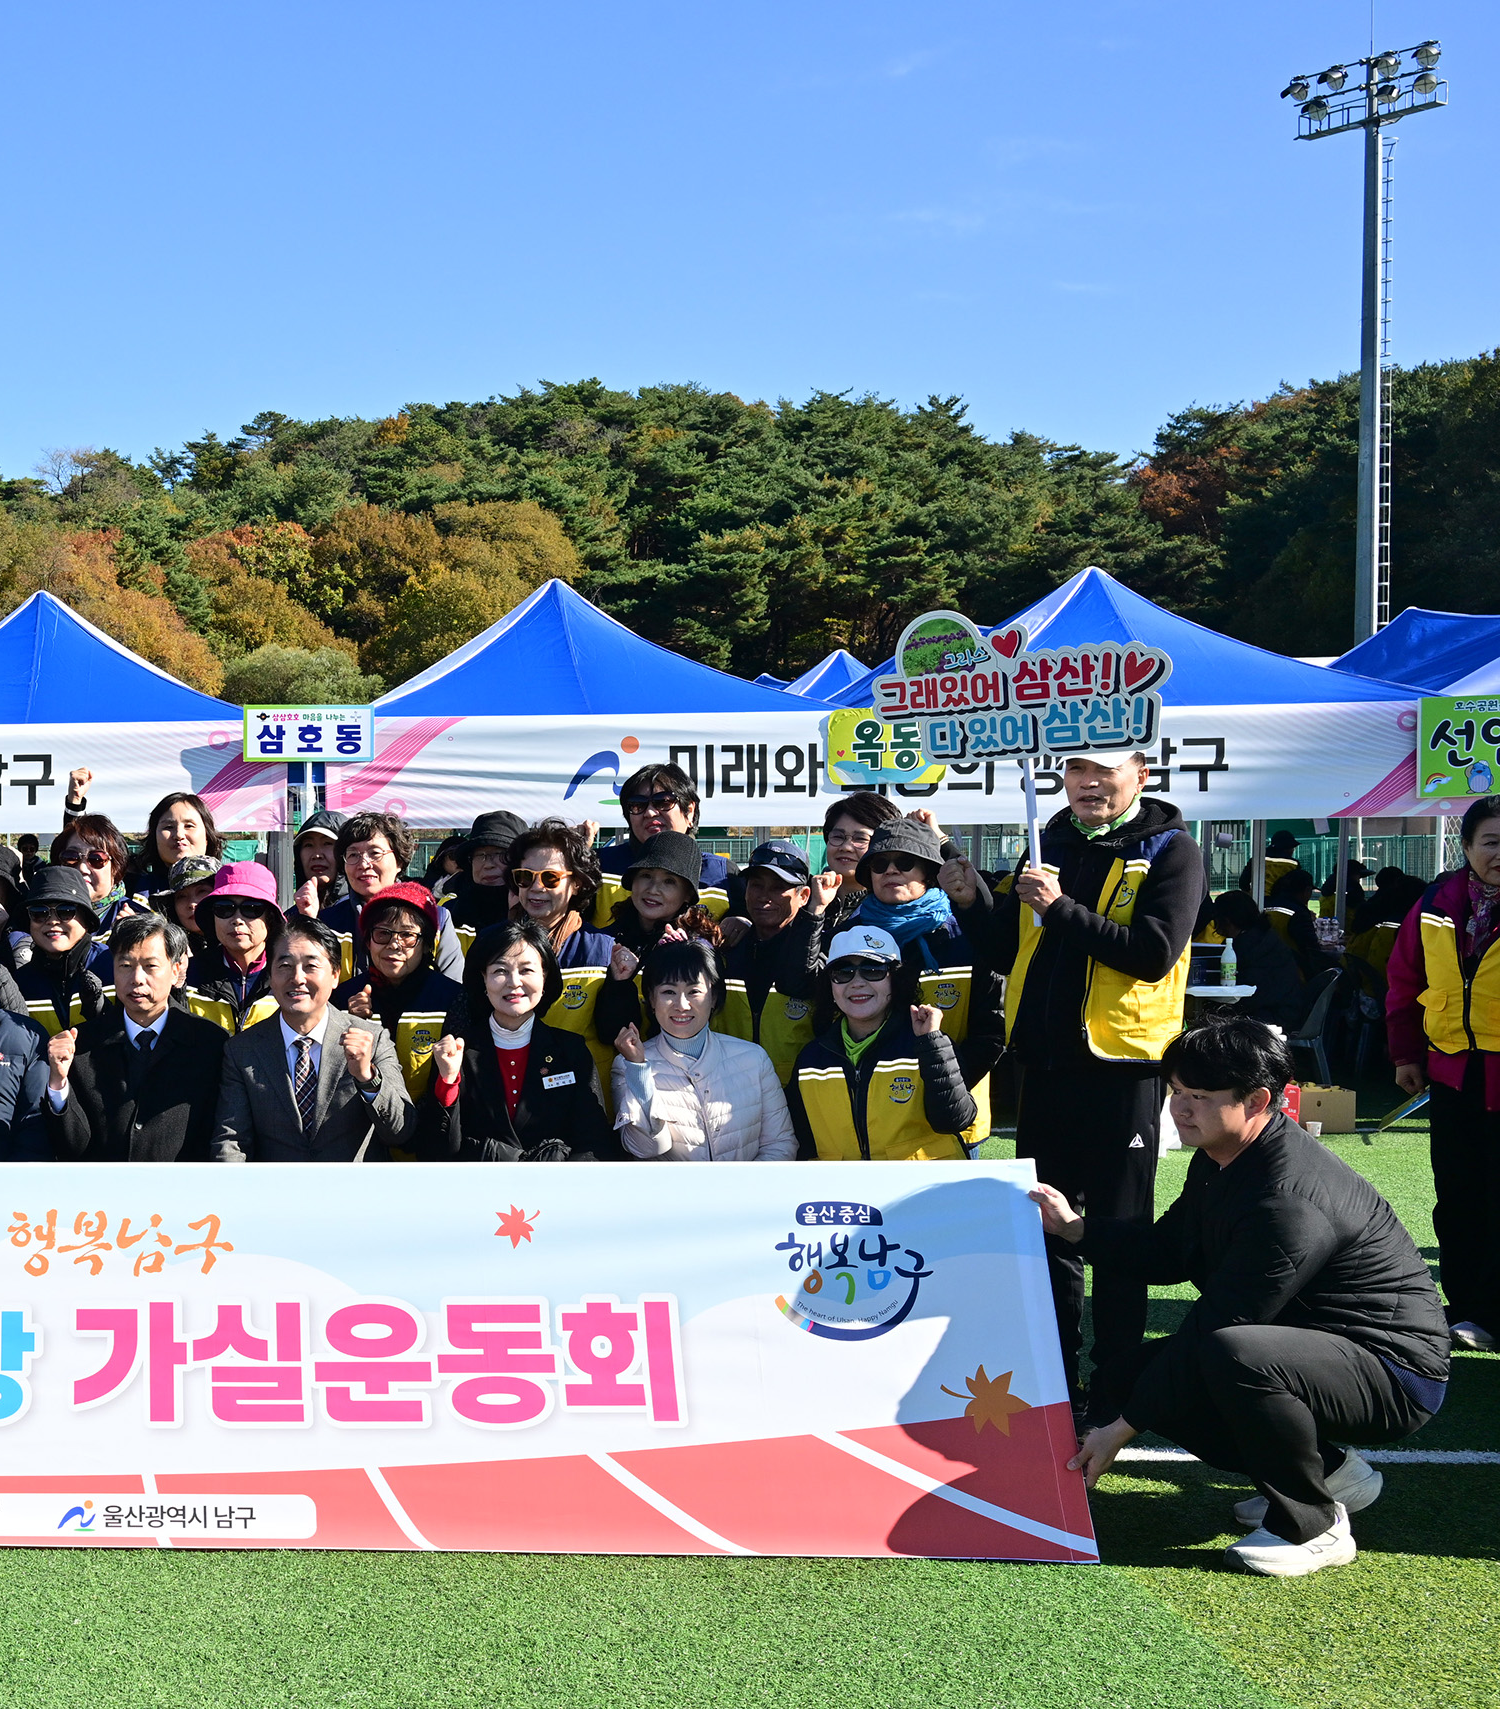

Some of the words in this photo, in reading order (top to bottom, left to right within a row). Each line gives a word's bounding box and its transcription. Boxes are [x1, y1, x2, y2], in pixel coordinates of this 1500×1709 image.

[944, 647, 988, 669] 그라스
[880, 672, 999, 713] 그래있어
[1014, 651, 1113, 702] 삼산!
[256, 724, 362, 755] 삼호동
[302, 713, 322, 722] 마음을
[325, 713, 346, 722] 나누는
[1042, 695, 1145, 742] 삼산!
[852, 720, 922, 770] 옥동
[668, 743, 823, 798] 미래와
[802, 1205, 834, 1224] 울산
[838, 1205, 871, 1224] 중심
[7, 1209, 233, 1277] 행복남구
[774, 1232, 934, 1306] 행복남구
[796, 1301, 808, 1313] The
[808, 1307, 826, 1320] heart
[858, 1314, 879, 1325] Happy
[878, 1299, 899, 1316] Namgu
[73, 1302, 680, 1425] 가실운동회
[102, 1503, 207, 1530] 울산광역시
[213, 1503, 256, 1530] 남구
